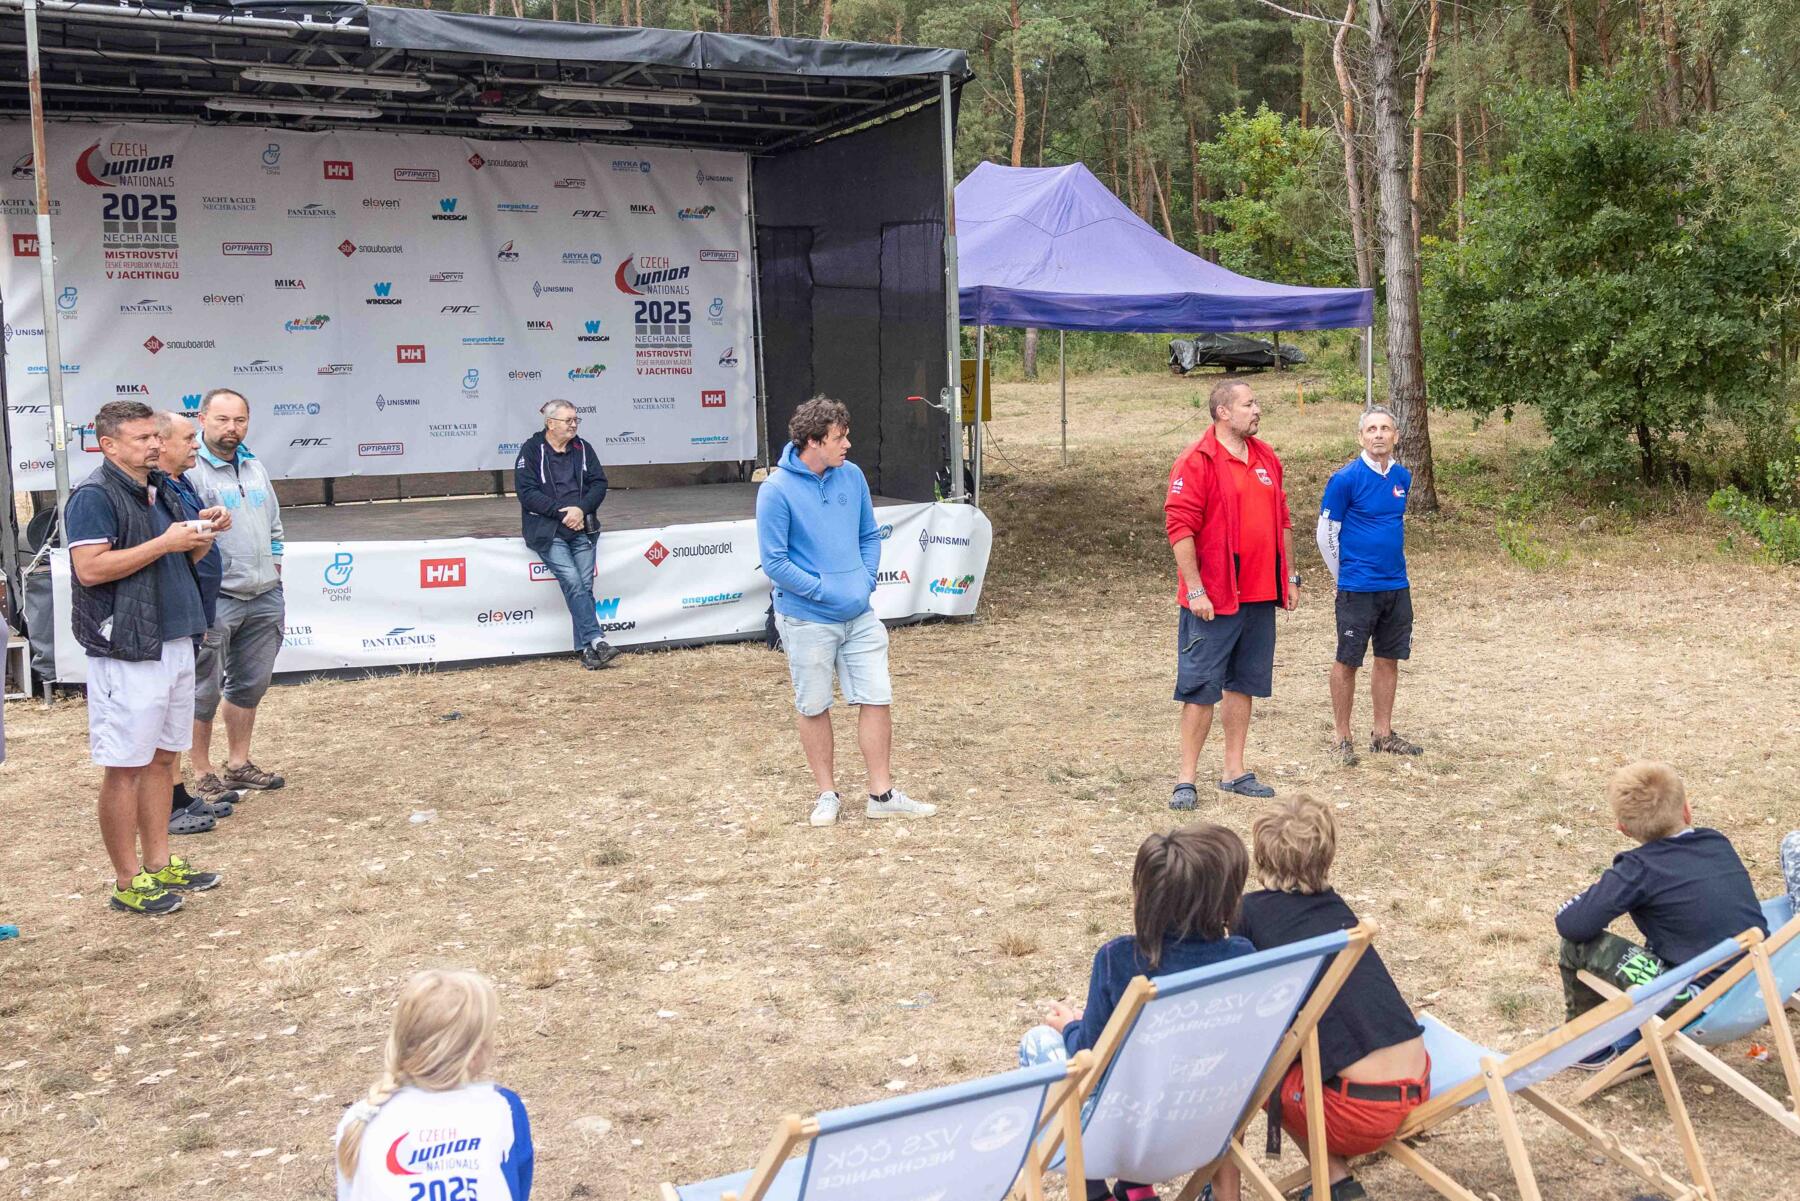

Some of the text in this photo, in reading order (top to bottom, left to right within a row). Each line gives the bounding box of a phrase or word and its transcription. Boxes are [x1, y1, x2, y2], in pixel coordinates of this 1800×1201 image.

[110, 143, 148, 156] CZECH
[101, 154, 174, 177] JUNIOR
[487, 159, 528, 168] snowboardel
[396, 170, 437, 178] OPTIPARTS
[119, 175, 175, 187] NATIONALS
[102, 193, 178, 221] 2025
[362, 198, 400, 208] eleven
[630, 204, 656, 214] MIKA
[103, 233, 177, 243] NECHRANICE
[105, 249, 178, 259] MISTROVSTVÍ
[359, 245, 403, 253] snowboardel
[640, 257, 669, 269] CZECH
[106, 271, 179, 280] V JACHTINGU
[633, 266, 690, 287] JUNIOR
[274, 279, 306, 289] MIKA
[647, 286, 690, 295] NATIONALS
[203, 294, 243, 303] eleven
[634, 300, 692, 324] 2025
[527, 320, 554, 330] MIKA
[166, 340, 215, 349] snowboardel
[462, 336, 505, 344] oneyacht.cz
[636, 350, 692, 358] MISTROVSTVÍ
[27, 364, 81, 372] oneyht.cz
[637, 367, 693, 375] V JACHTINGU
[508, 370, 542, 379] eleven
[116, 384, 149, 394] MIKA
[274, 403, 305, 411] ARYKA
[361, 444, 401, 452] OPTIPARTS
[19, 459, 55, 470] eleve
[929, 535, 970, 546] UNISMINI
[649, 542, 733, 560] sbl snowboardel
[876, 570, 911, 583] MIKA
[682, 592, 743, 605] oneyacht.cz
[478, 607, 534, 623] eleven
[284, 626, 312, 635] CLUB
[601, 620, 636, 632] DESIGN
[362, 634, 436, 648] PANTAENIUS
[419, 1128, 456, 1142] CZECH
[408, 1137, 482, 1166] JUNIOR
[426, 1159, 480, 1171] NATIONALS
[409, 1176, 478, 1201] 2025
